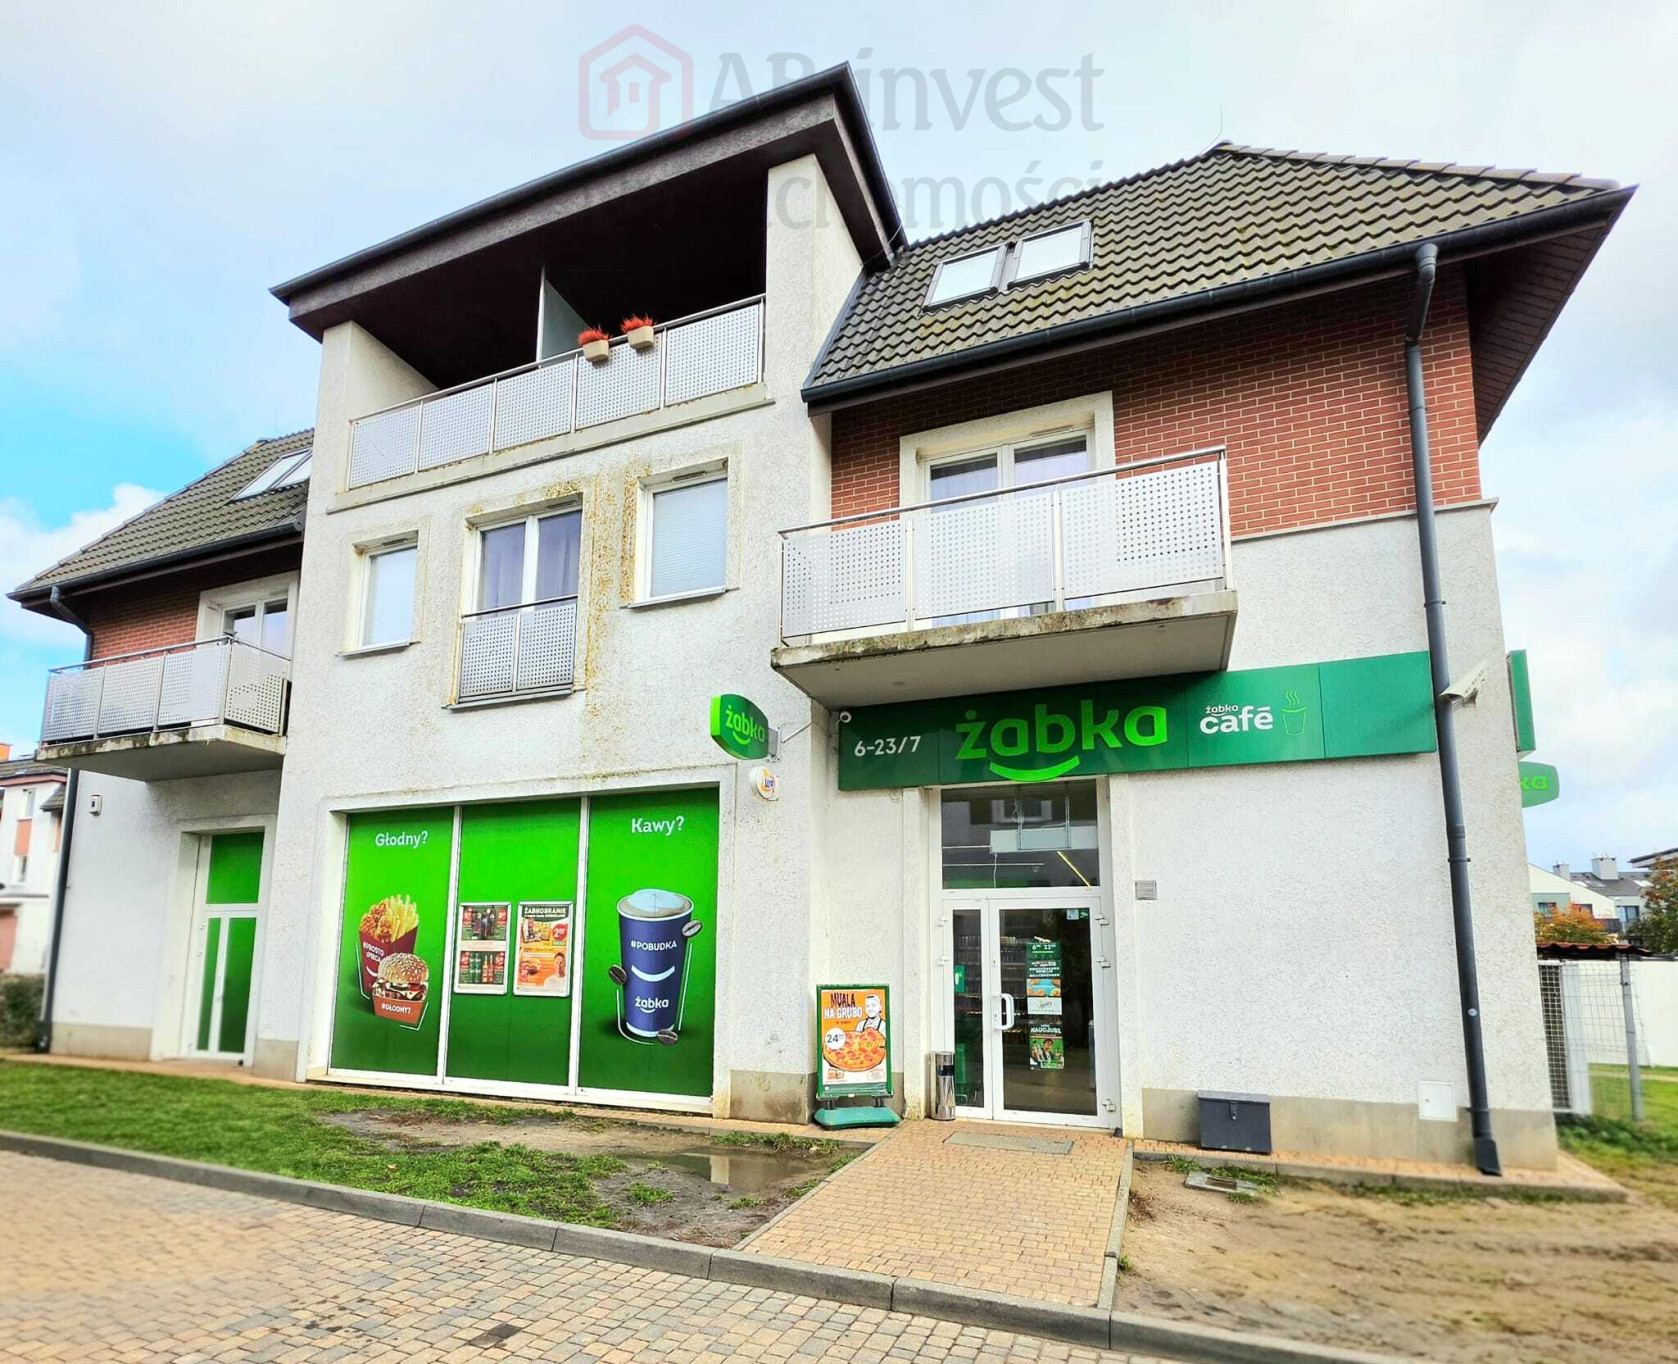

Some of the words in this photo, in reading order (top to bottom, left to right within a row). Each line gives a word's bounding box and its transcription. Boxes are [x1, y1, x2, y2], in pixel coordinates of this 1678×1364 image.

[1199, 705, 1274, 735] café
[1205, 704, 1239, 715] żabka
[725, 704, 766, 743] żabka
[955, 700, 1168, 760] żabka
[854, 735, 921, 757] 6-23/7
[631, 815, 685, 836] Kawy?
[375, 830, 429, 849] Głodny?
[630, 940, 678, 951] #POBUDKA
[634, 996, 669, 1008] żabka
